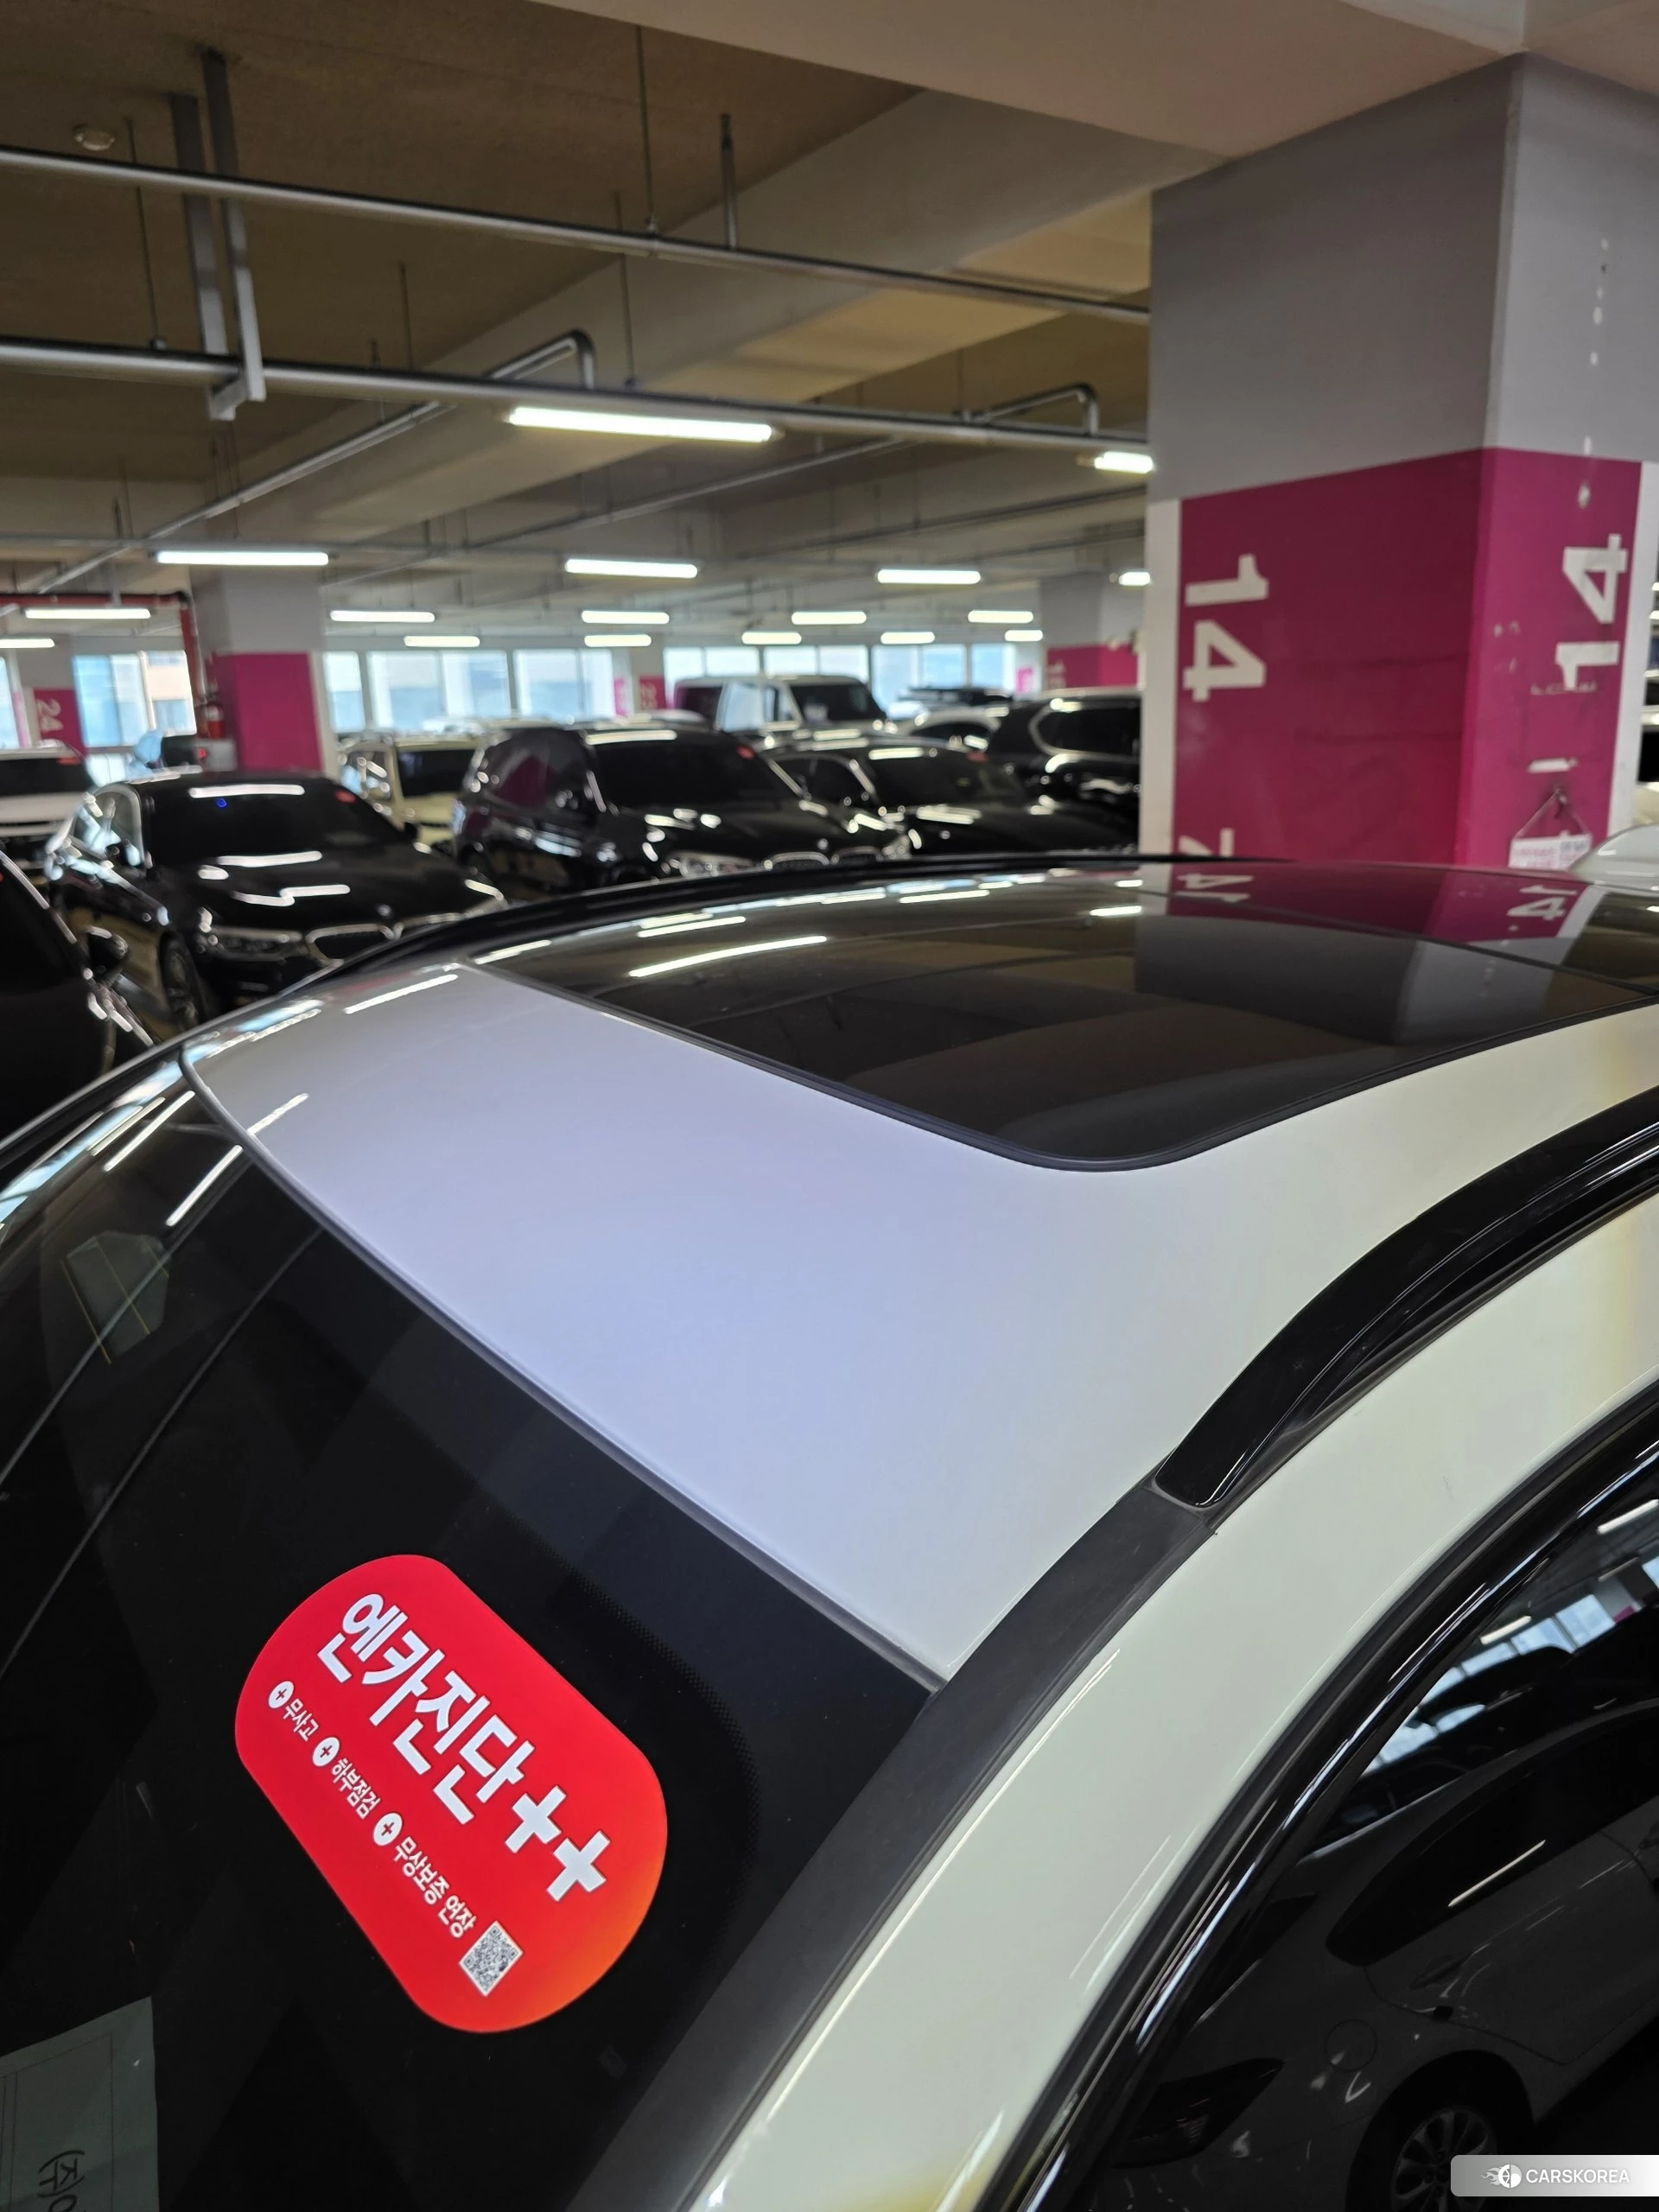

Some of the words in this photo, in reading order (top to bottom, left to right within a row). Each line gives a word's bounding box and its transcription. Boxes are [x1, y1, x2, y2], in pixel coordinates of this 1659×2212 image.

[1183, 553, 1268, 702] 14
[1556, 533, 1628, 690] 14
[37, 698, 64, 734] 24
[283, 1698, 320, 1741] 무사고
[331, 1758, 381, 1819] 하부점검
[393, 1836, 449, 1904] 무상보증
[438, 1895, 477, 1938] 연장
[317, 1593, 610, 1901] 엔카진단++
